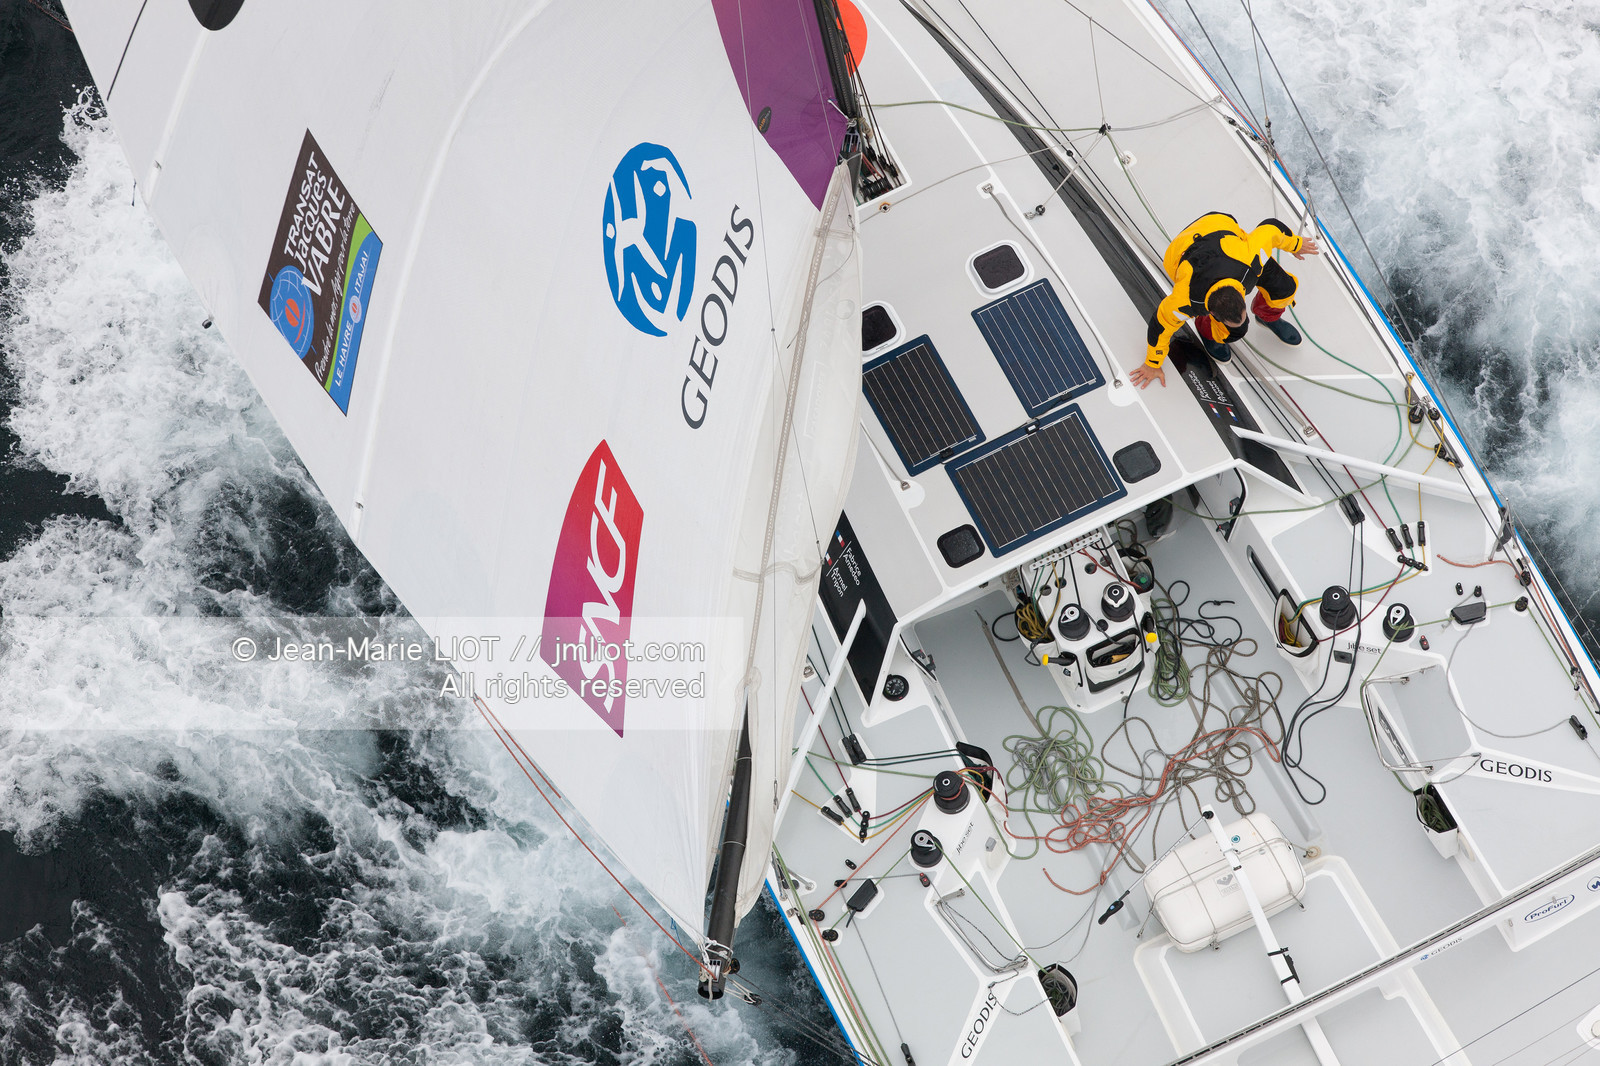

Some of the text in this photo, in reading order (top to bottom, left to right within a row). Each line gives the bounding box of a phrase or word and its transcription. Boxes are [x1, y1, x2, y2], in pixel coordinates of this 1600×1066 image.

[284, 151, 318, 257] TRANSAT
[301, 177, 346, 296] VABRE
[353, 250, 369, 295] ITAJAI
[681, 204, 754, 430] GEODIS
[335, 320, 353, 387] LE HAVRE
[578, 458, 626, 714] SNCF
[830, 572, 844, 597] Tripon
[833, 567, 848, 591] Armel
[843, 554, 860, 586] Amedeo
[846, 547, 861, 577] Fabrice
[1480, 759, 1552, 783] GEODIS
[961, 992, 998, 1059] GEODIS
